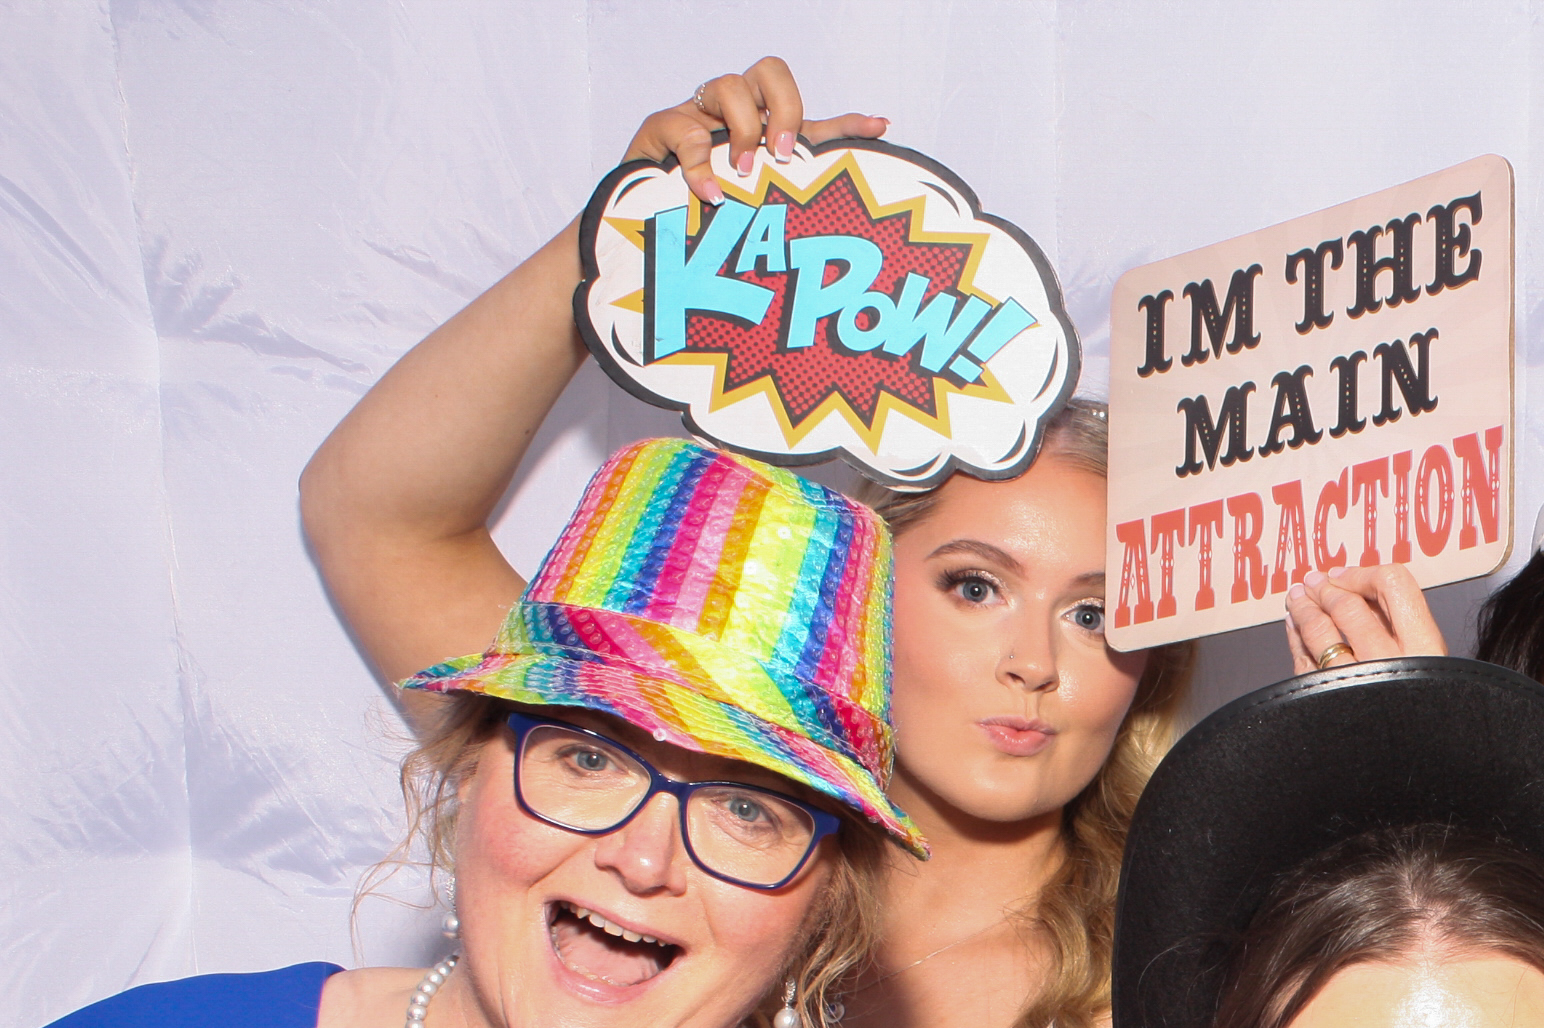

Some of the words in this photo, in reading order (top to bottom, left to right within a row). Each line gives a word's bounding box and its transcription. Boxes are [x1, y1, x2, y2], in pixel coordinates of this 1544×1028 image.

[1137, 263, 1263, 377] IM
[1285, 190, 1483, 335] THE
[1175, 327, 1440, 478] MAIN
[1114, 424, 1504, 629] ATTRACTION
